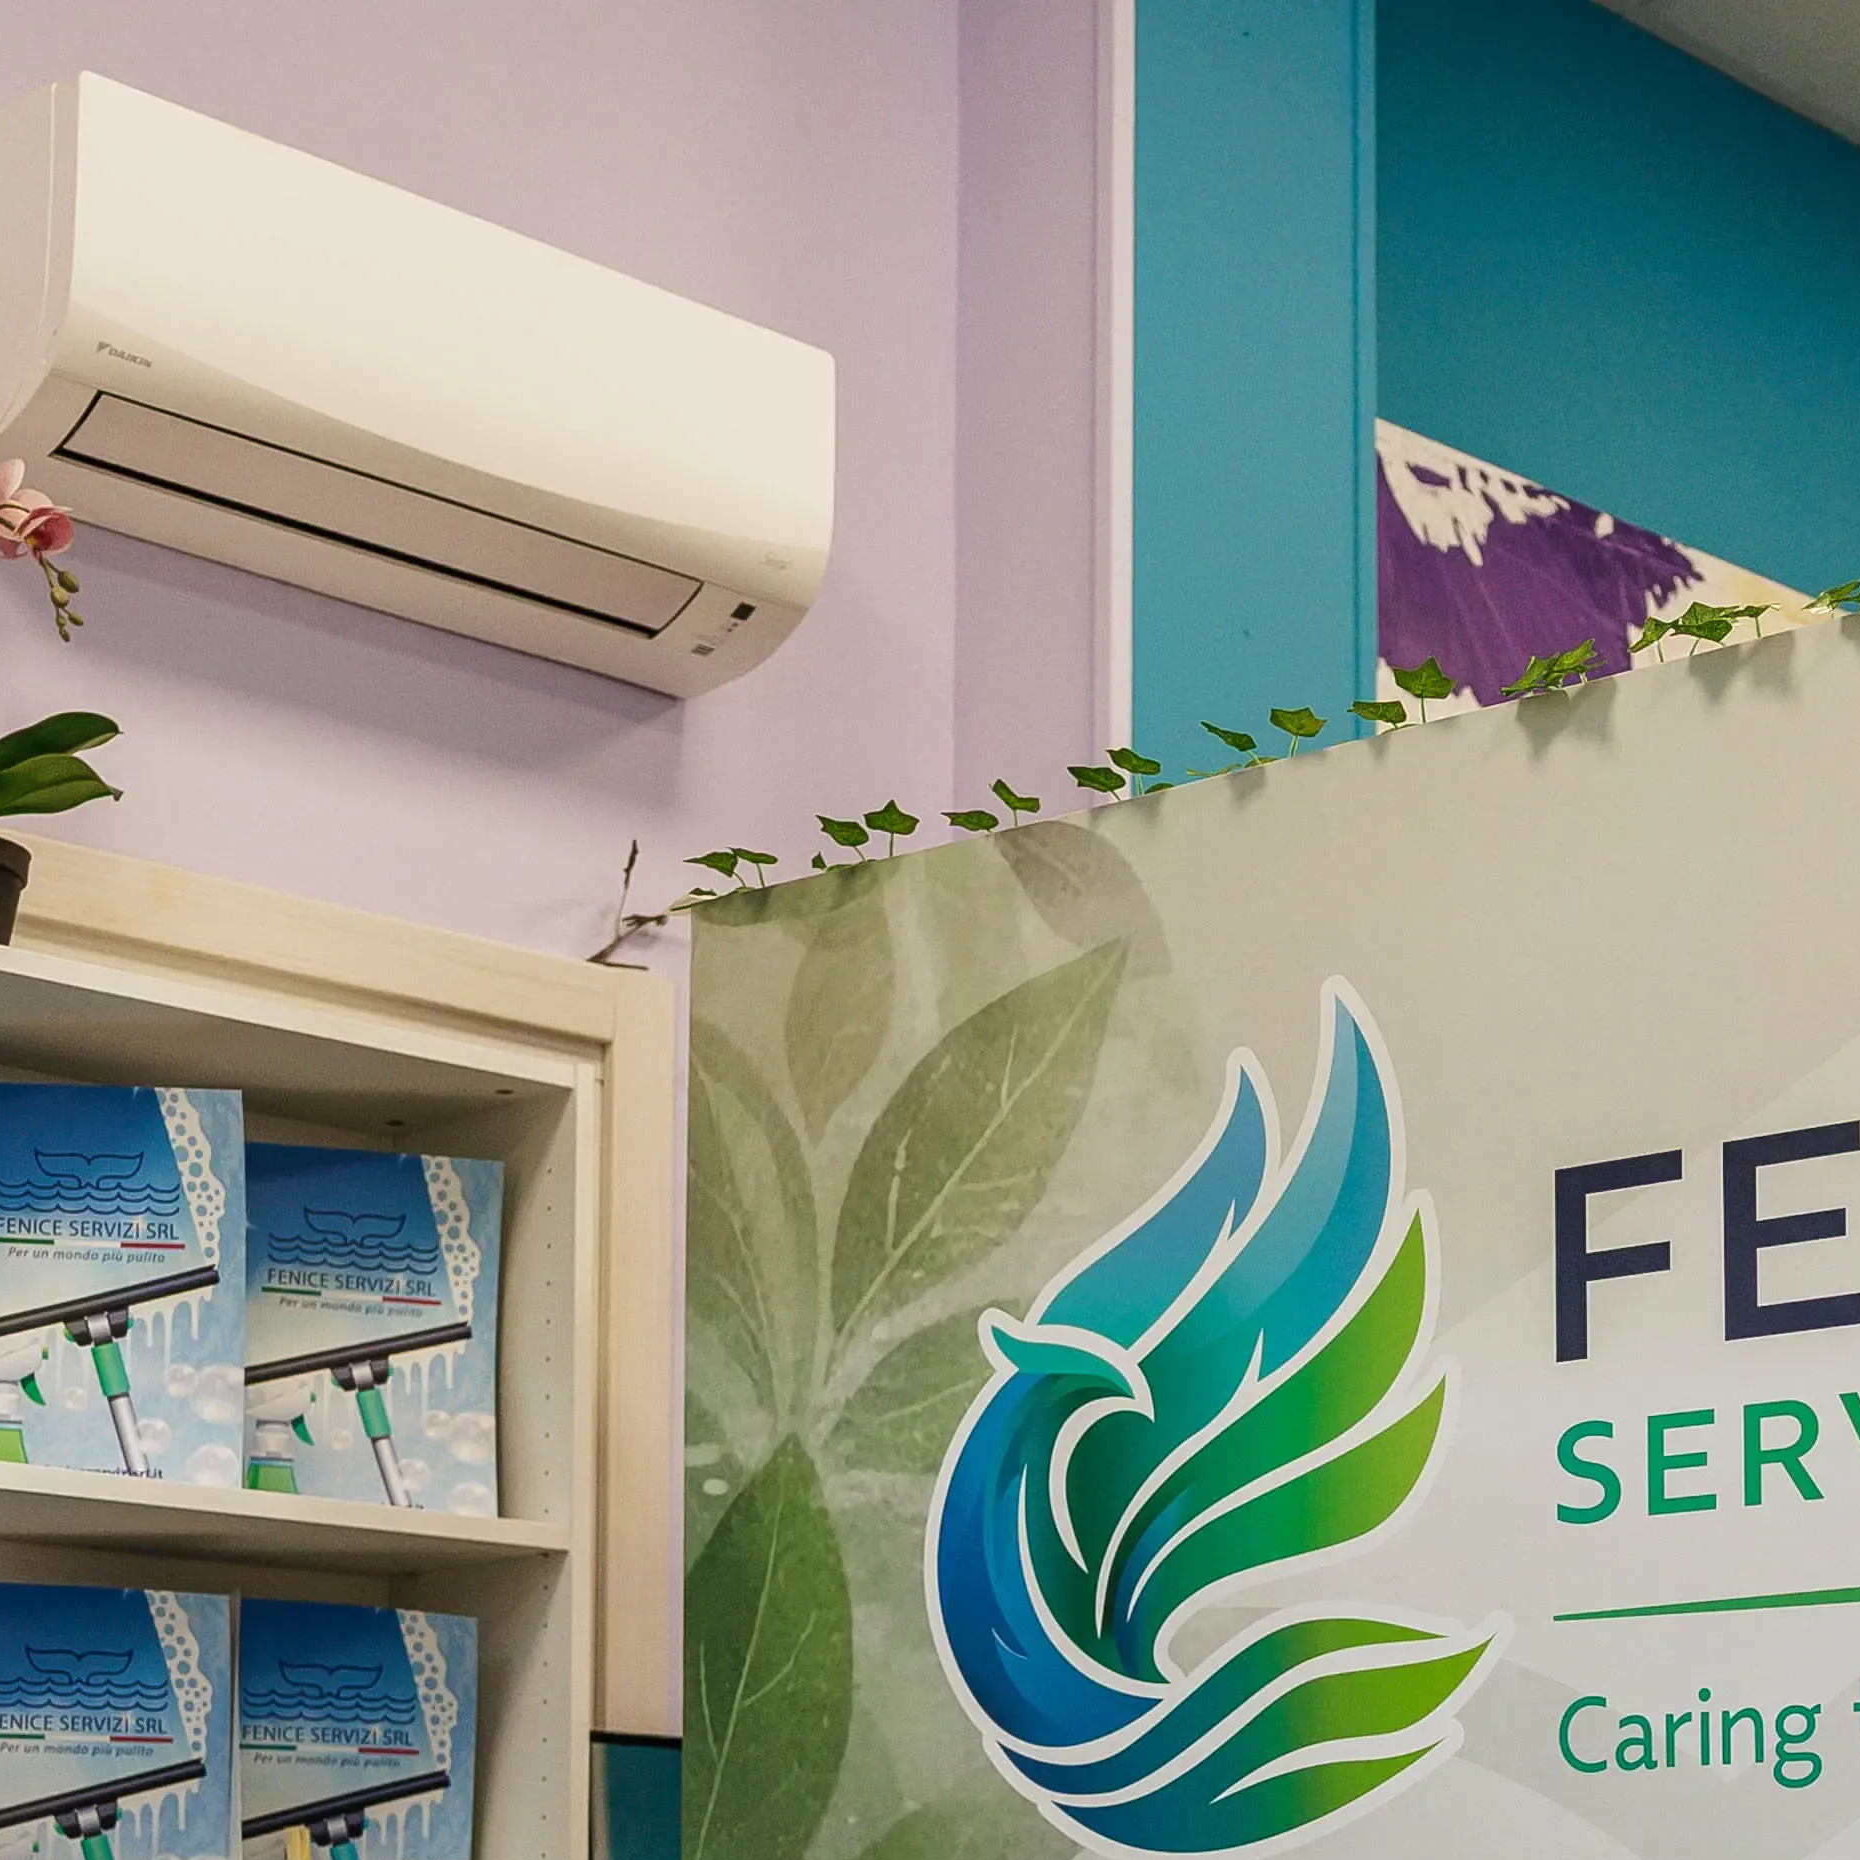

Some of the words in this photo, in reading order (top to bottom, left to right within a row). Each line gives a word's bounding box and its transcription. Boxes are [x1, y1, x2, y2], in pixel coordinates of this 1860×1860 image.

[69, 1220, 140, 1239] SERVIZI
[146, 1222, 180, 1240] SRL
[7, 1246, 29, 1258] Per
[33, 1249, 50, 1259] un
[53, 1250, 99, 1261] mondo
[126, 1252, 166, 1264] pulito
[267, 1268, 330, 1289] FENICE
[334, 1273, 401, 1294] SERVIZI
[406, 1280, 436, 1297] SRL
[59, 1715, 129, 1733] SERVIZI
[136, 1717, 169, 1734] SRL
[242, 1724, 305, 1743] FENICE
[310, 1727, 377, 1745] SERVIZI
[382, 1730, 413, 1747] SRL
[1558, 1688, 1823, 1789] Caring
[0, 1742, 19, 1753] Per
[23, 1744, 40, 1754] un
[43, 1744, 89, 1755] mondo
